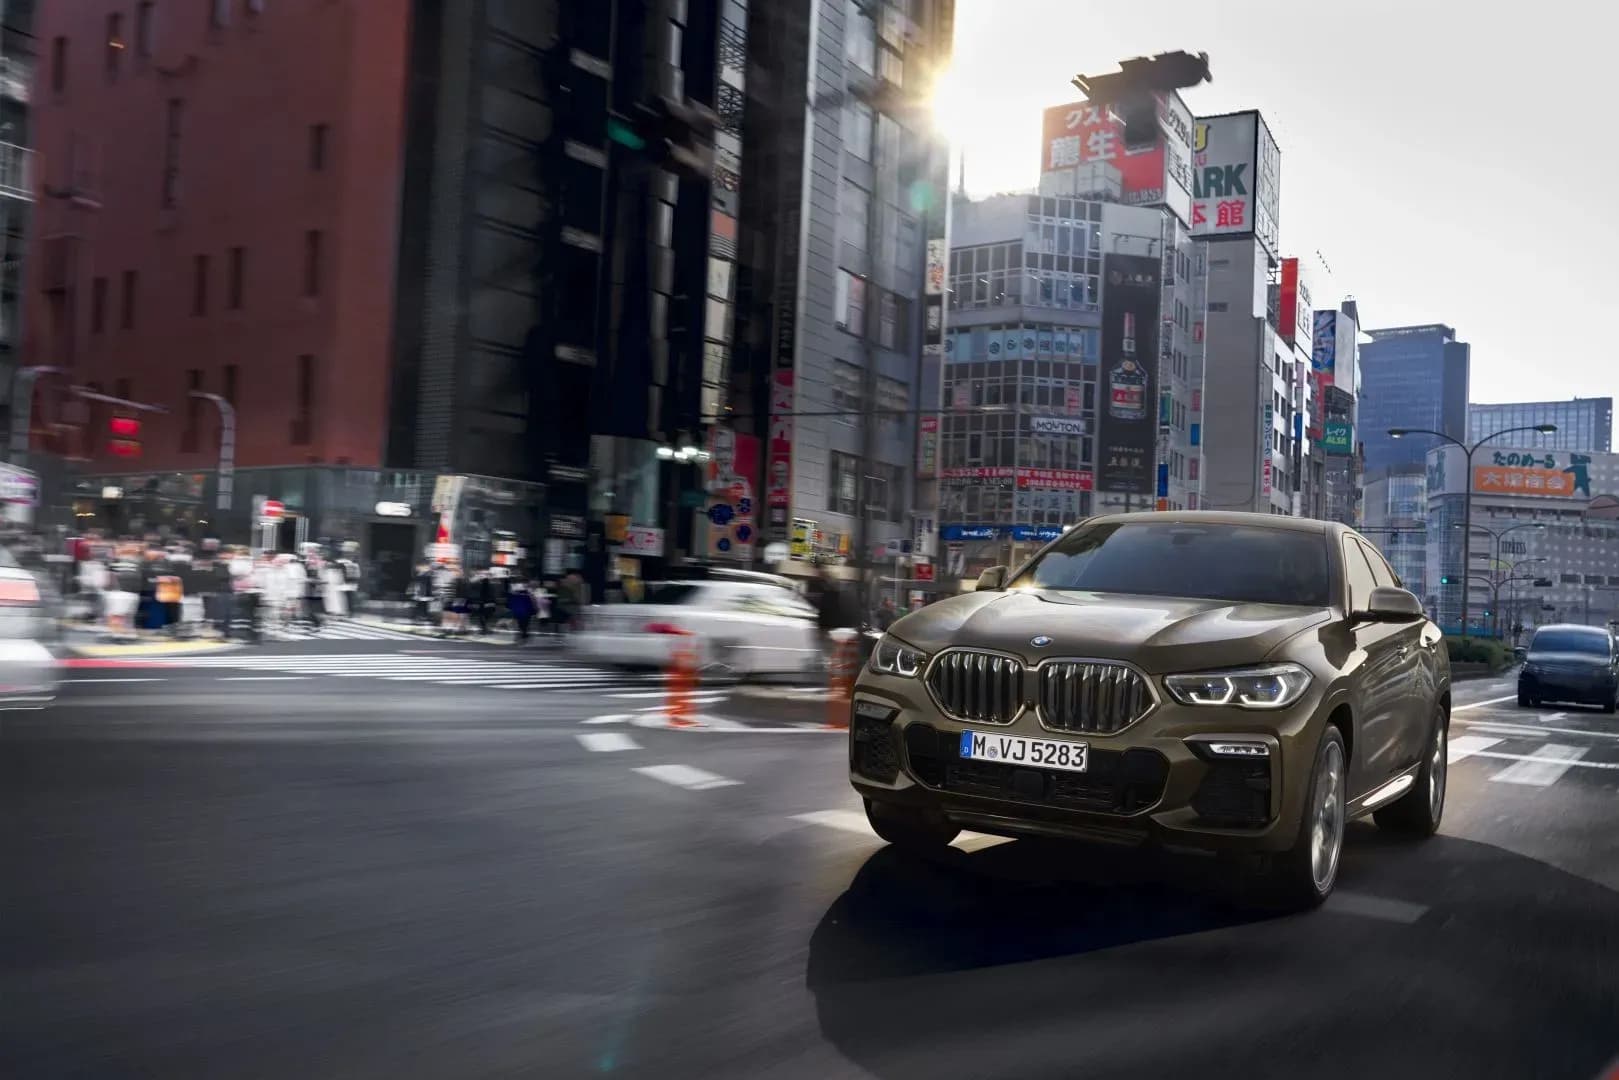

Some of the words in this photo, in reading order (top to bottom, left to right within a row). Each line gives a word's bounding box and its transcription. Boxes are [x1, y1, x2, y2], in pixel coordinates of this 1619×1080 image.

[1493, 451, 1556, 469] たのめーる
[973, 735, 986, 756] M
[999, 738, 1026, 761] VJ
[1031, 741, 1086, 767] 5283
